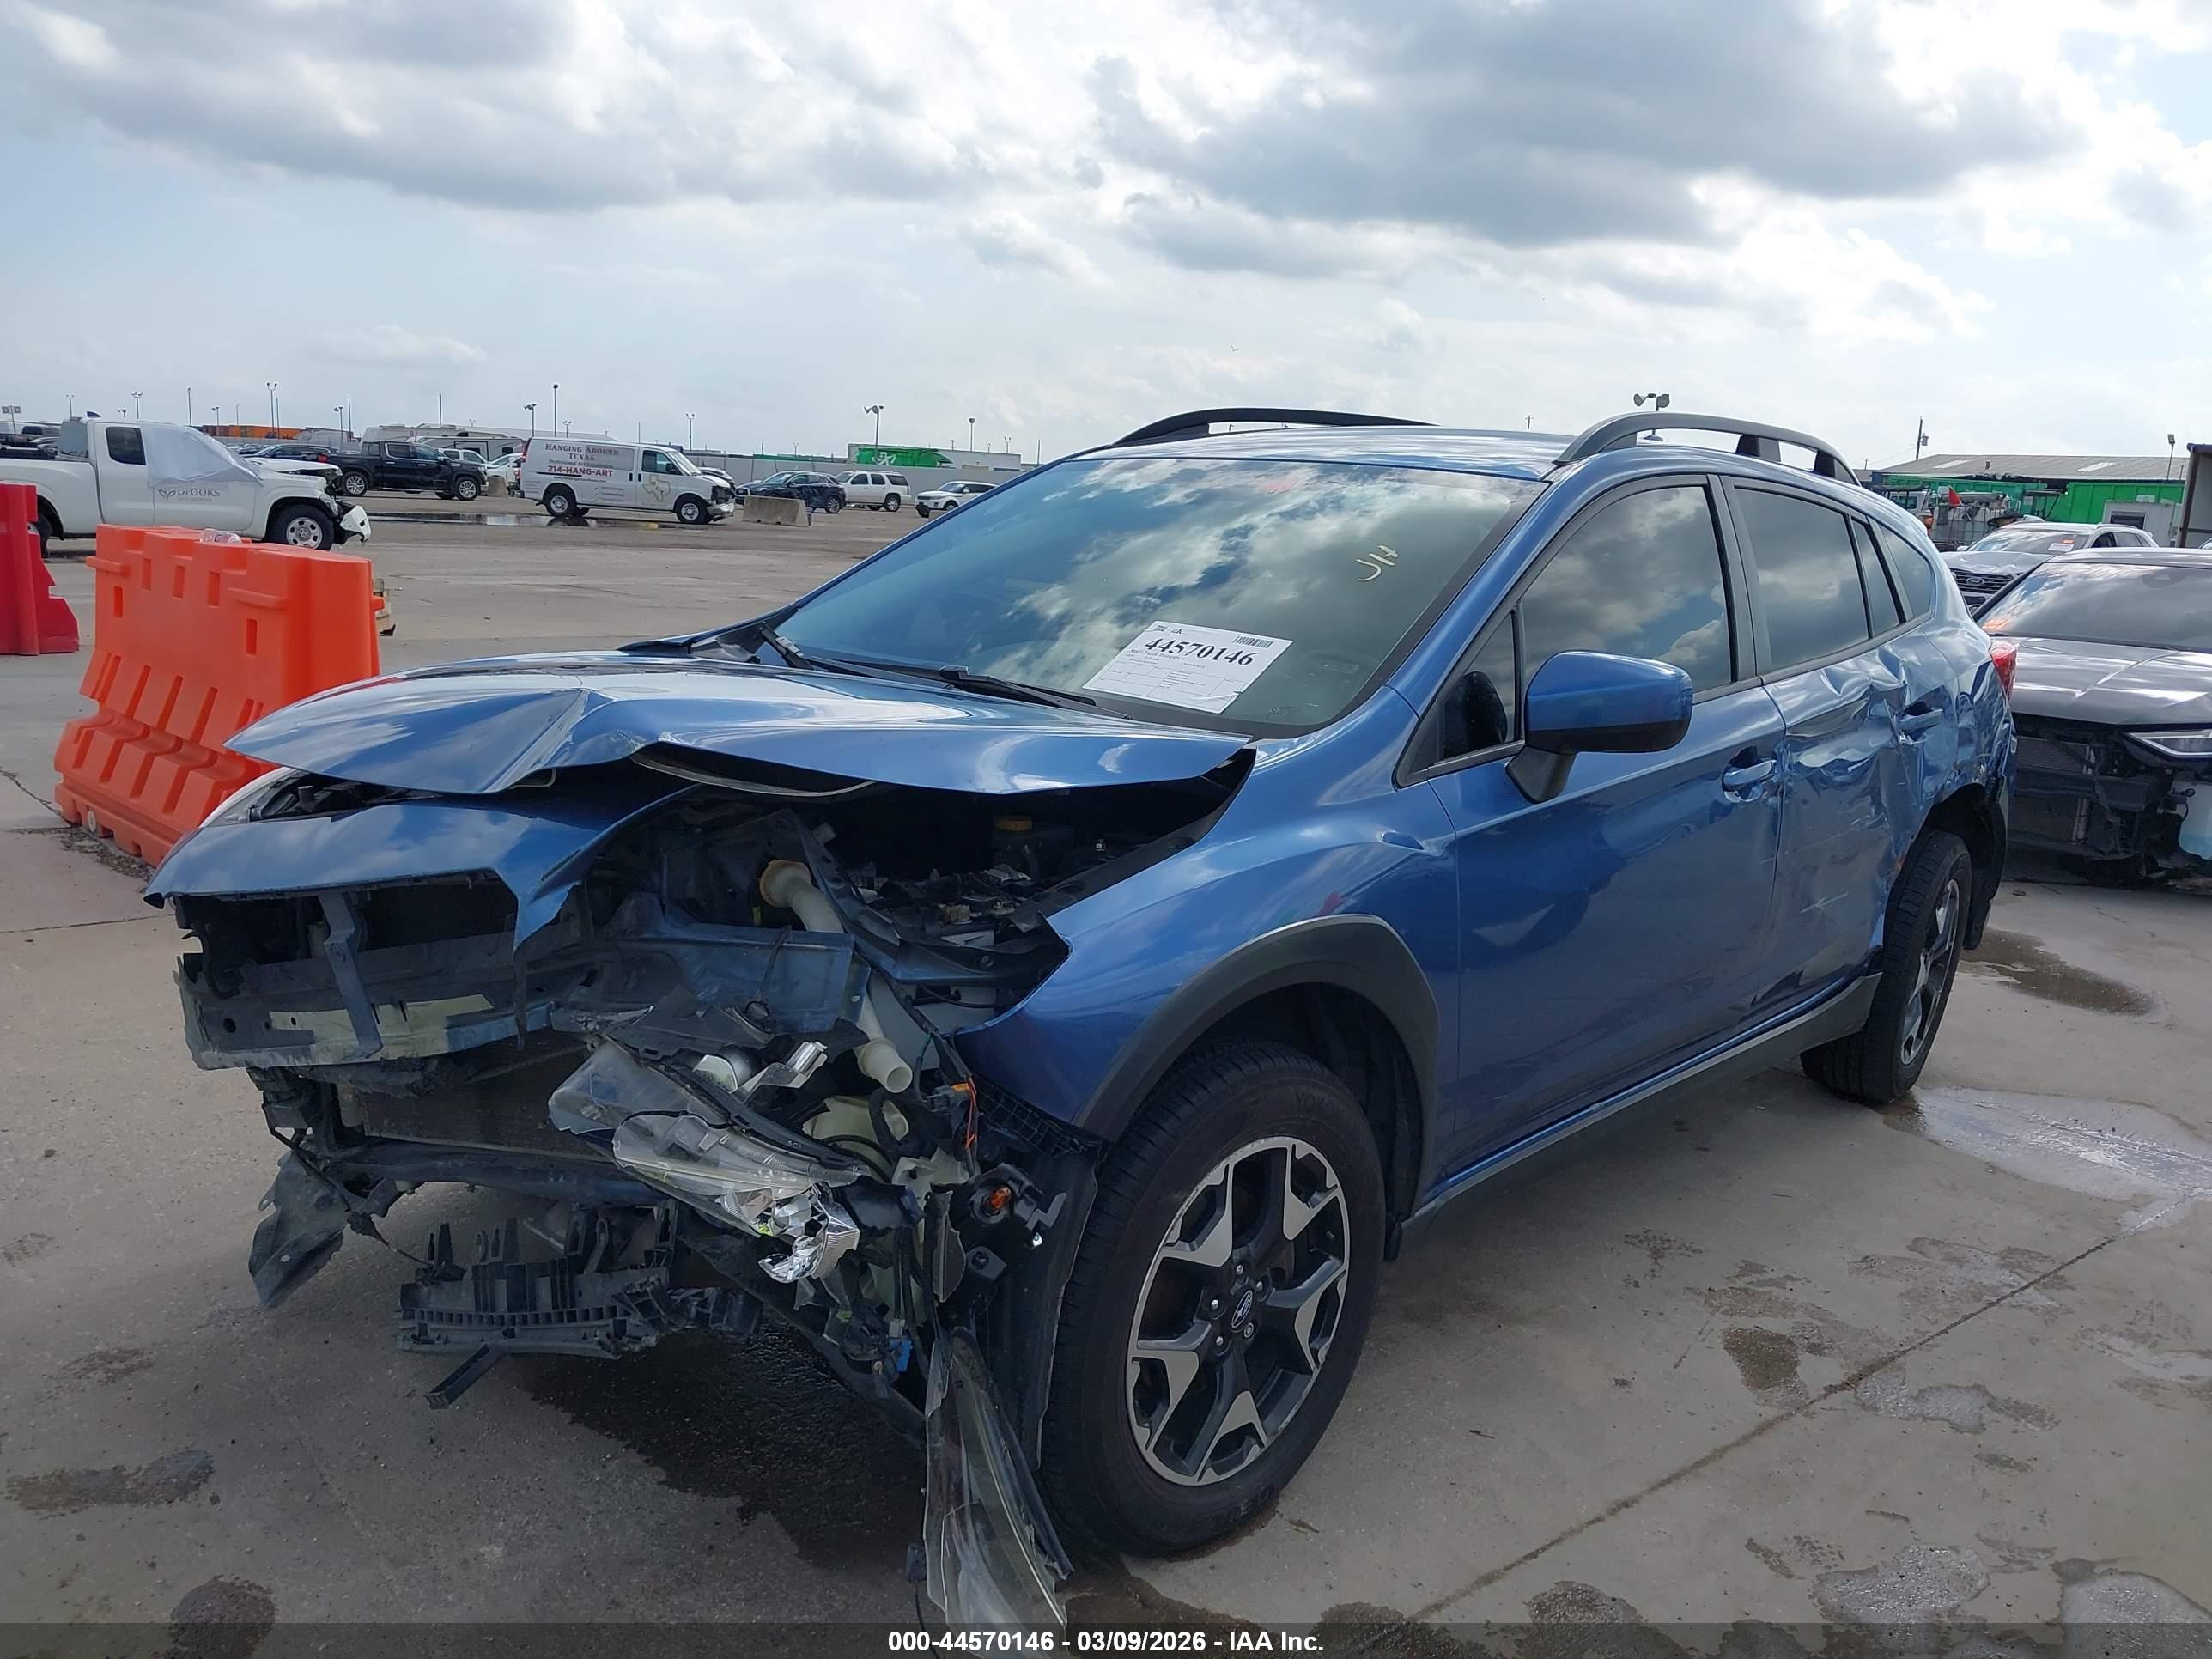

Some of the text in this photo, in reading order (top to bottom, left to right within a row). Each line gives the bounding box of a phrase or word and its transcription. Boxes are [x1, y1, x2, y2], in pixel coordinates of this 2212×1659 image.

[545, 443, 619, 455] HANGING AROUND
[568, 453, 595, 461] TEXAS
[548, 465, 614, 477] 214-HANG-ART
[1145, 638, 1260, 665] 44570146
